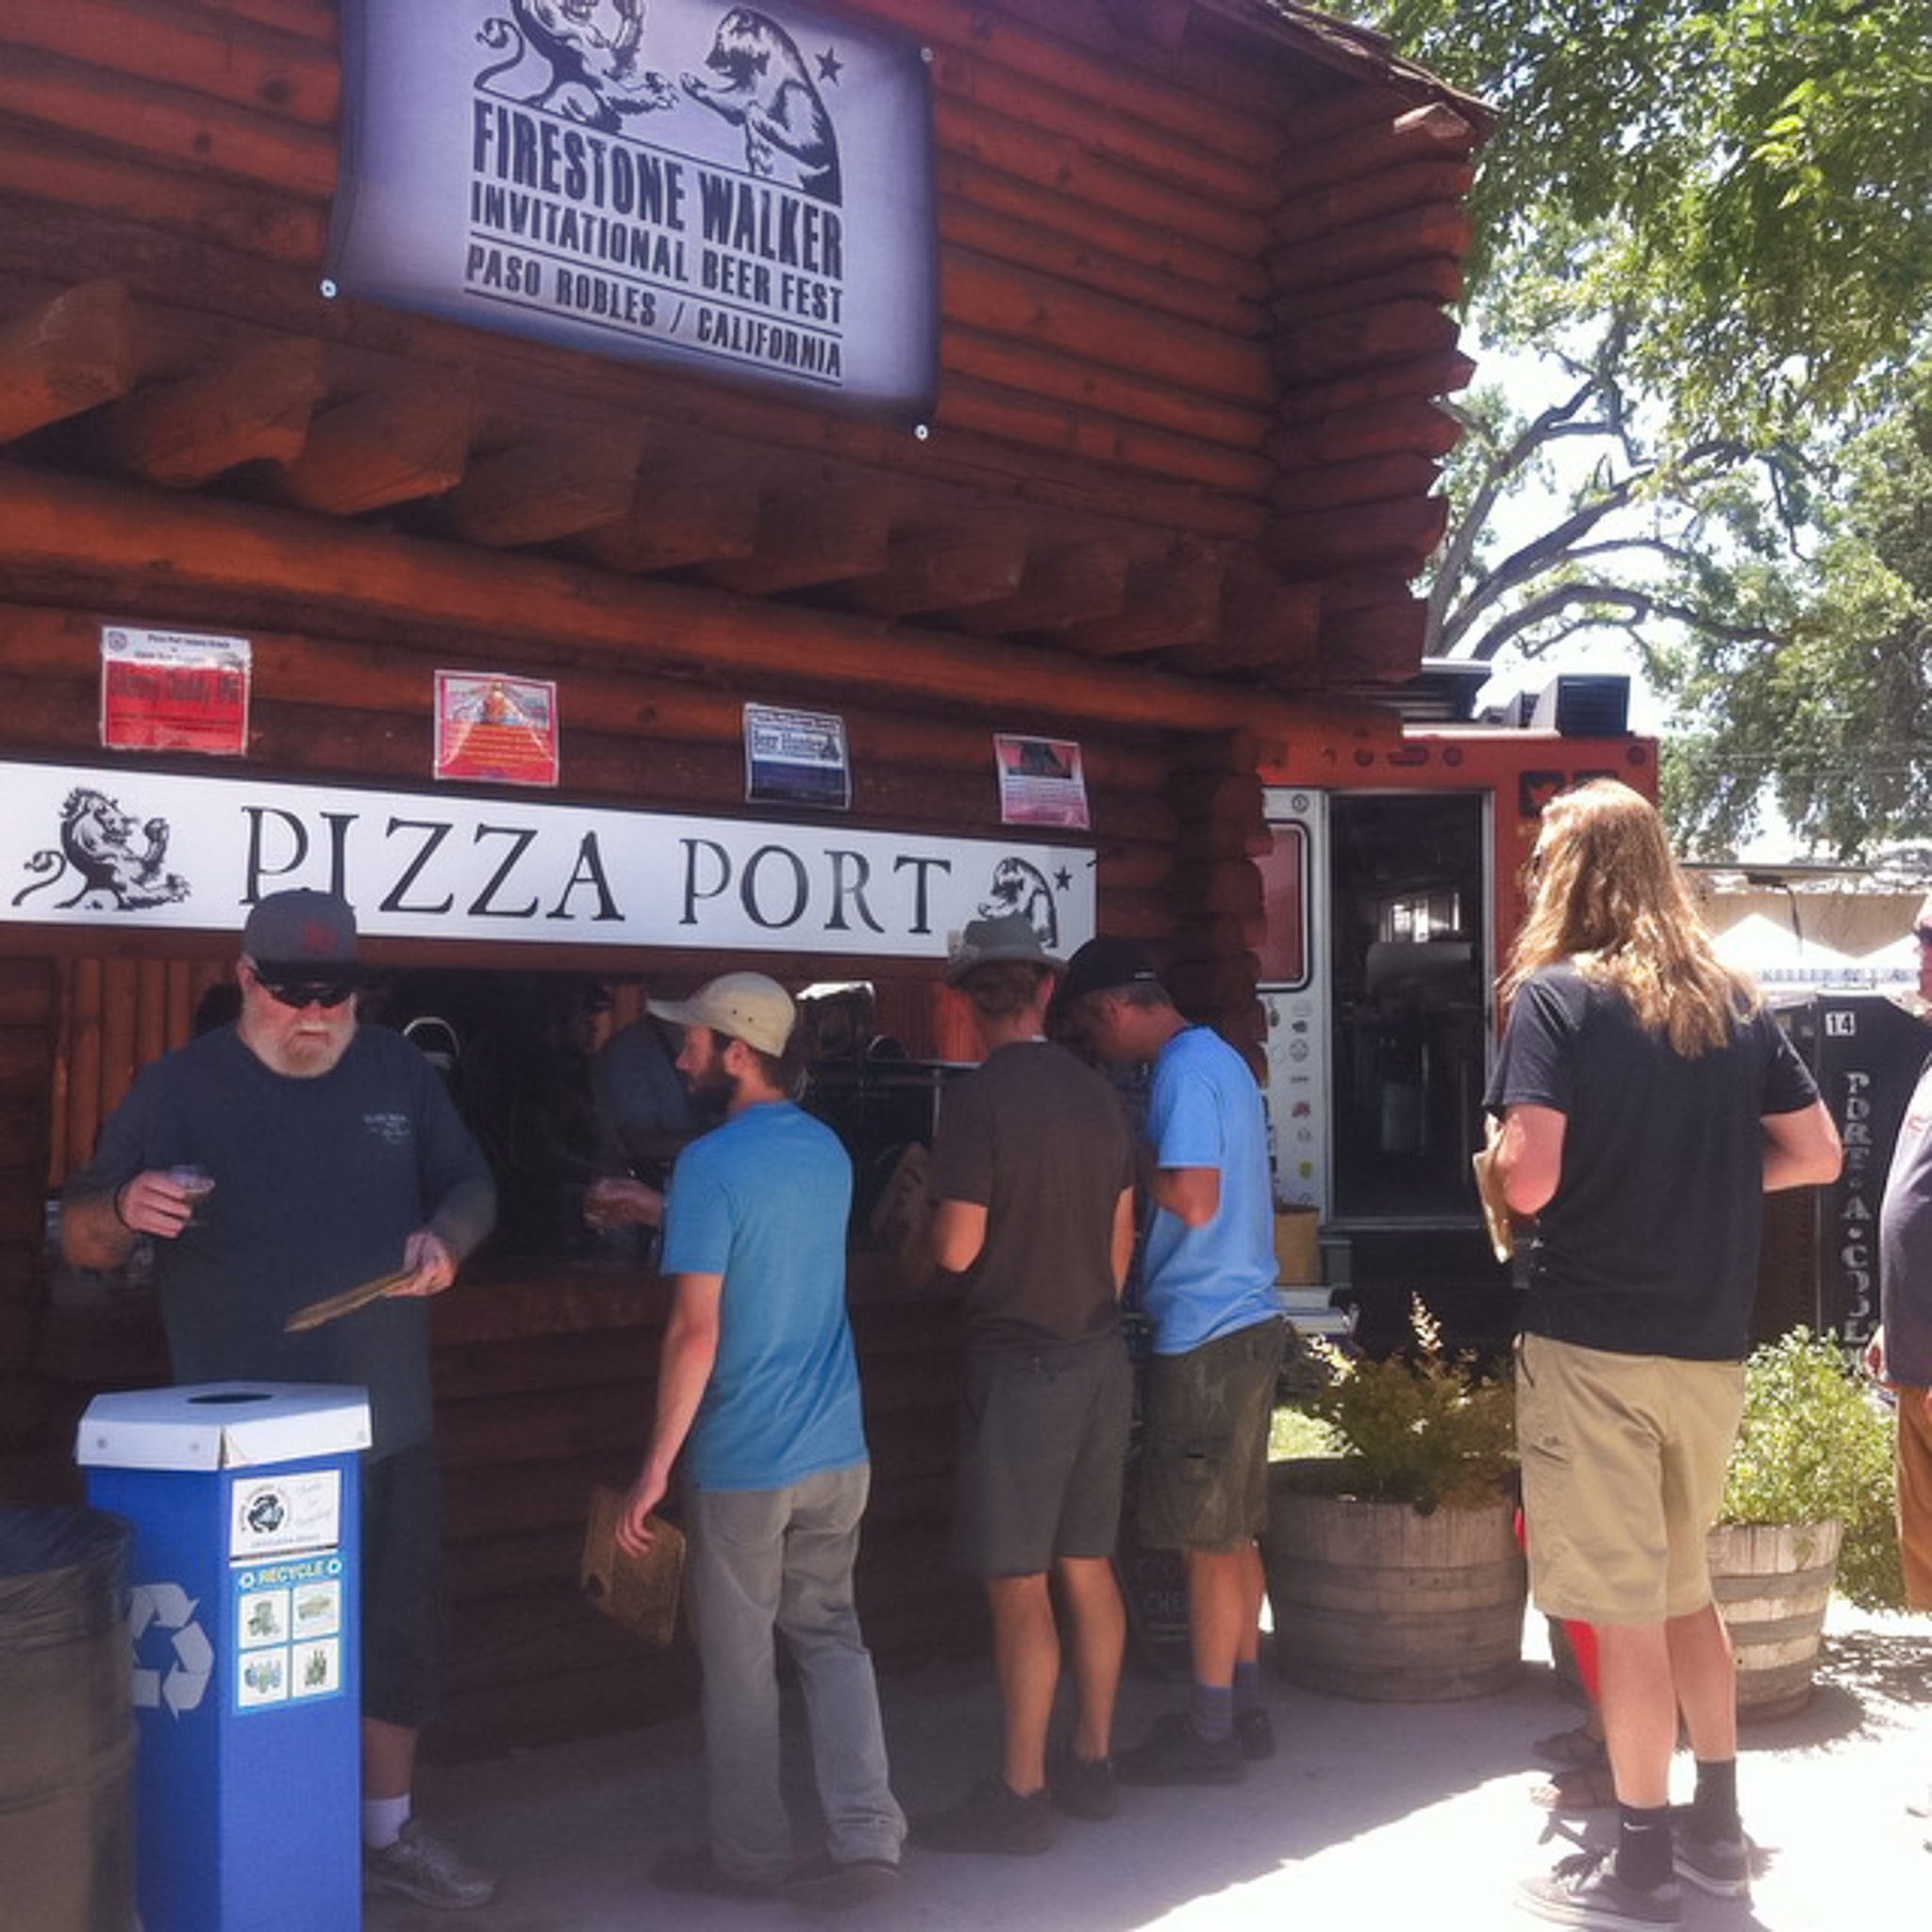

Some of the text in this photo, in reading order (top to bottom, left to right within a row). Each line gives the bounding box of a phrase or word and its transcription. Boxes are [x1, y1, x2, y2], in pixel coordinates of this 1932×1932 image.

[473, 181, 843, 325] INVITATIONAL BEER FEST
[474, 98, 842, 281] FIRESTONE WALKER
[467, 243, 542, 297] PASO
[556, 268, 657, 326] ROBLES
[697, 308, 841, 377] CALIFORNIA
[240, 806, 952, 934] PIZZA PORT
[1827, 1012, 1854, 1034] 14
[258, 1560, 325, 1583] RECYCLE
